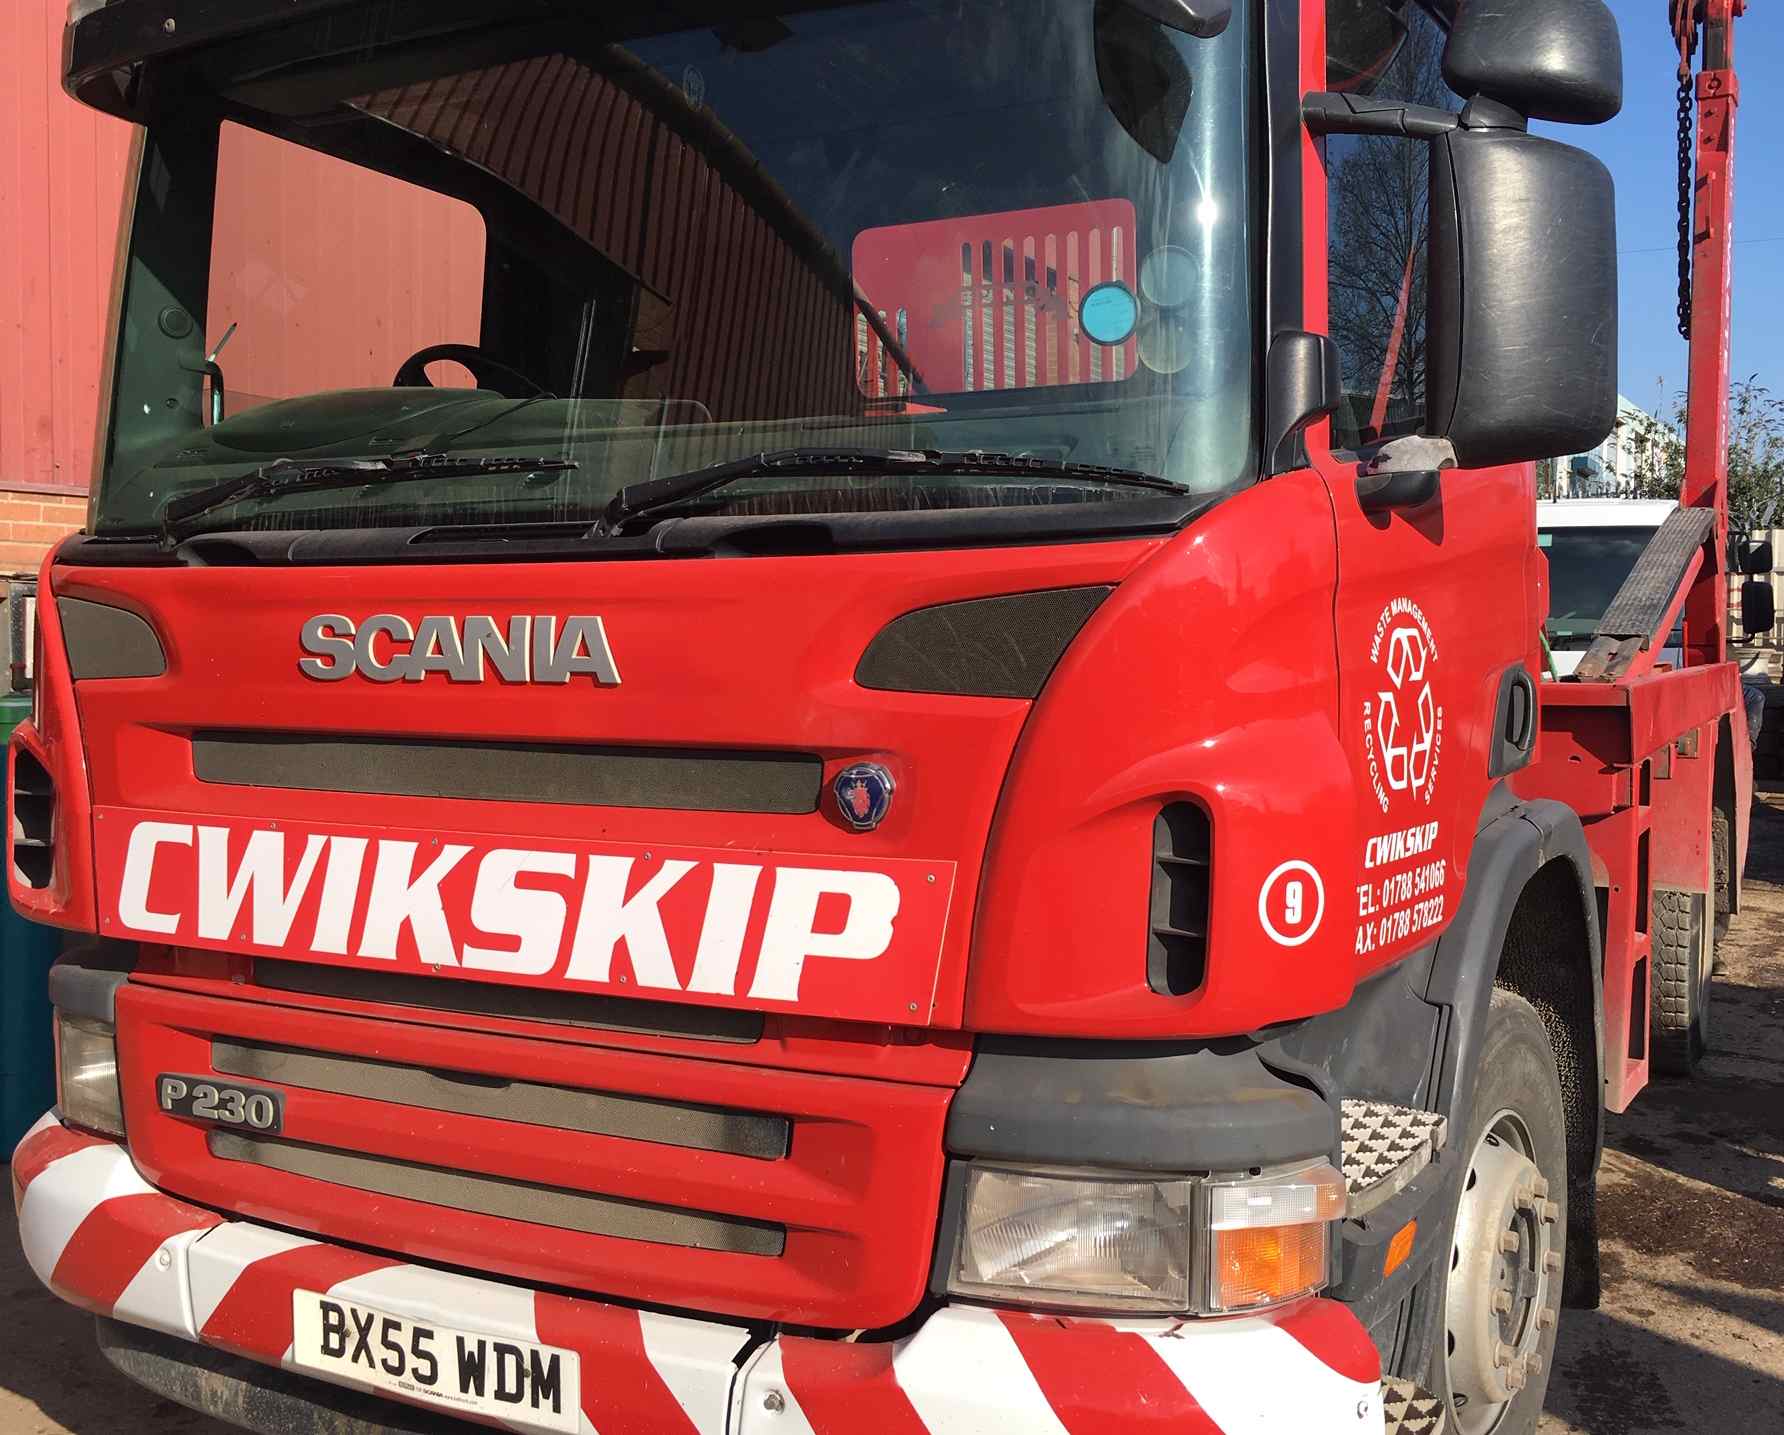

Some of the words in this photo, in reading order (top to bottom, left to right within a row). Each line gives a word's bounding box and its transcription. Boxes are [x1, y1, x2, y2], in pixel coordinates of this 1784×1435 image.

[298, 613, 622, 684] SCANIA
[1370, 606, 1392, 664] WASTE
[1391, 597, 1438, 663] MANAGEMENT
[1363, 701, 1389, 814] RECYCLING
[1424, 706, 1443, 806] SERVICES
[1364, 821, 1439, 869] CWIKSKIP
[118, 820, 902, 1001] CWIKSKIP
[1285, 880, 1303, 925] 9
[1356, 883, 1379, 917] EL:
[1382, 871, 1413, 908] 01788
[1415, 859, 1447, 896] 541066
[1355, 921, 1377, 955] AX:
[1379, 908, 1411, 947] 01788
[1412, 894, 1444, 933] 578222
[161, 1078, 187, 1110] P
[192, 1084, 274, 1129] 230
[320, 1300, 438, 1386] BX55
[456, 1335, 561, 1414] WDM
